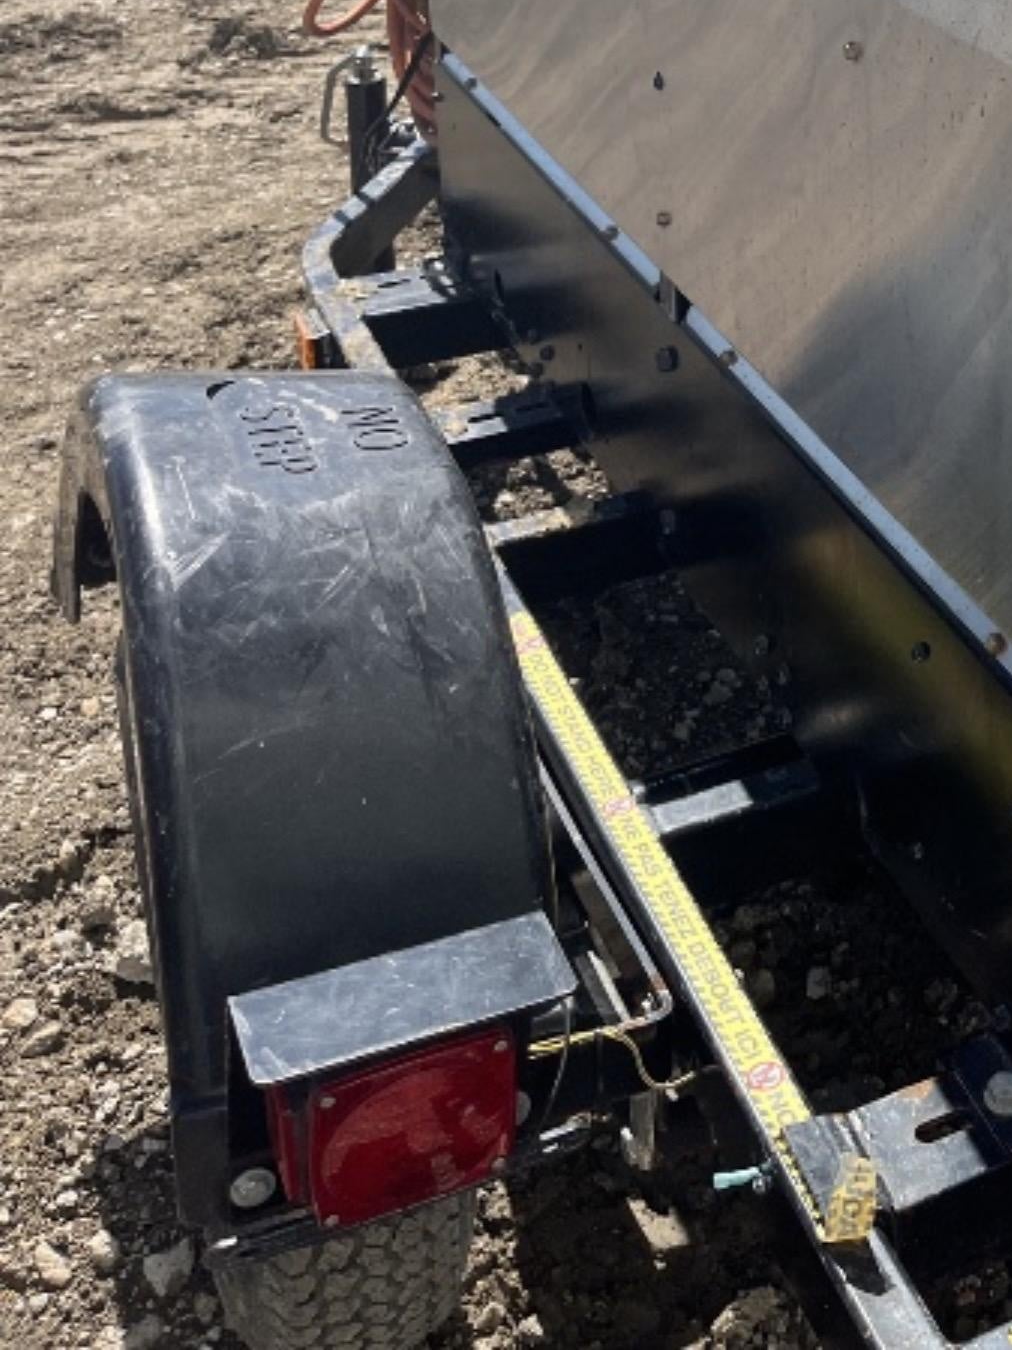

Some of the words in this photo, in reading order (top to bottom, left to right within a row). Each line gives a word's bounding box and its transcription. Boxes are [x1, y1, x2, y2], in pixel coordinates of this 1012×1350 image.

[239, 407, 319, 474] STEP
[340, 407, 409, 451] NO
[687, 940, 745, 1025] DEBOUT
